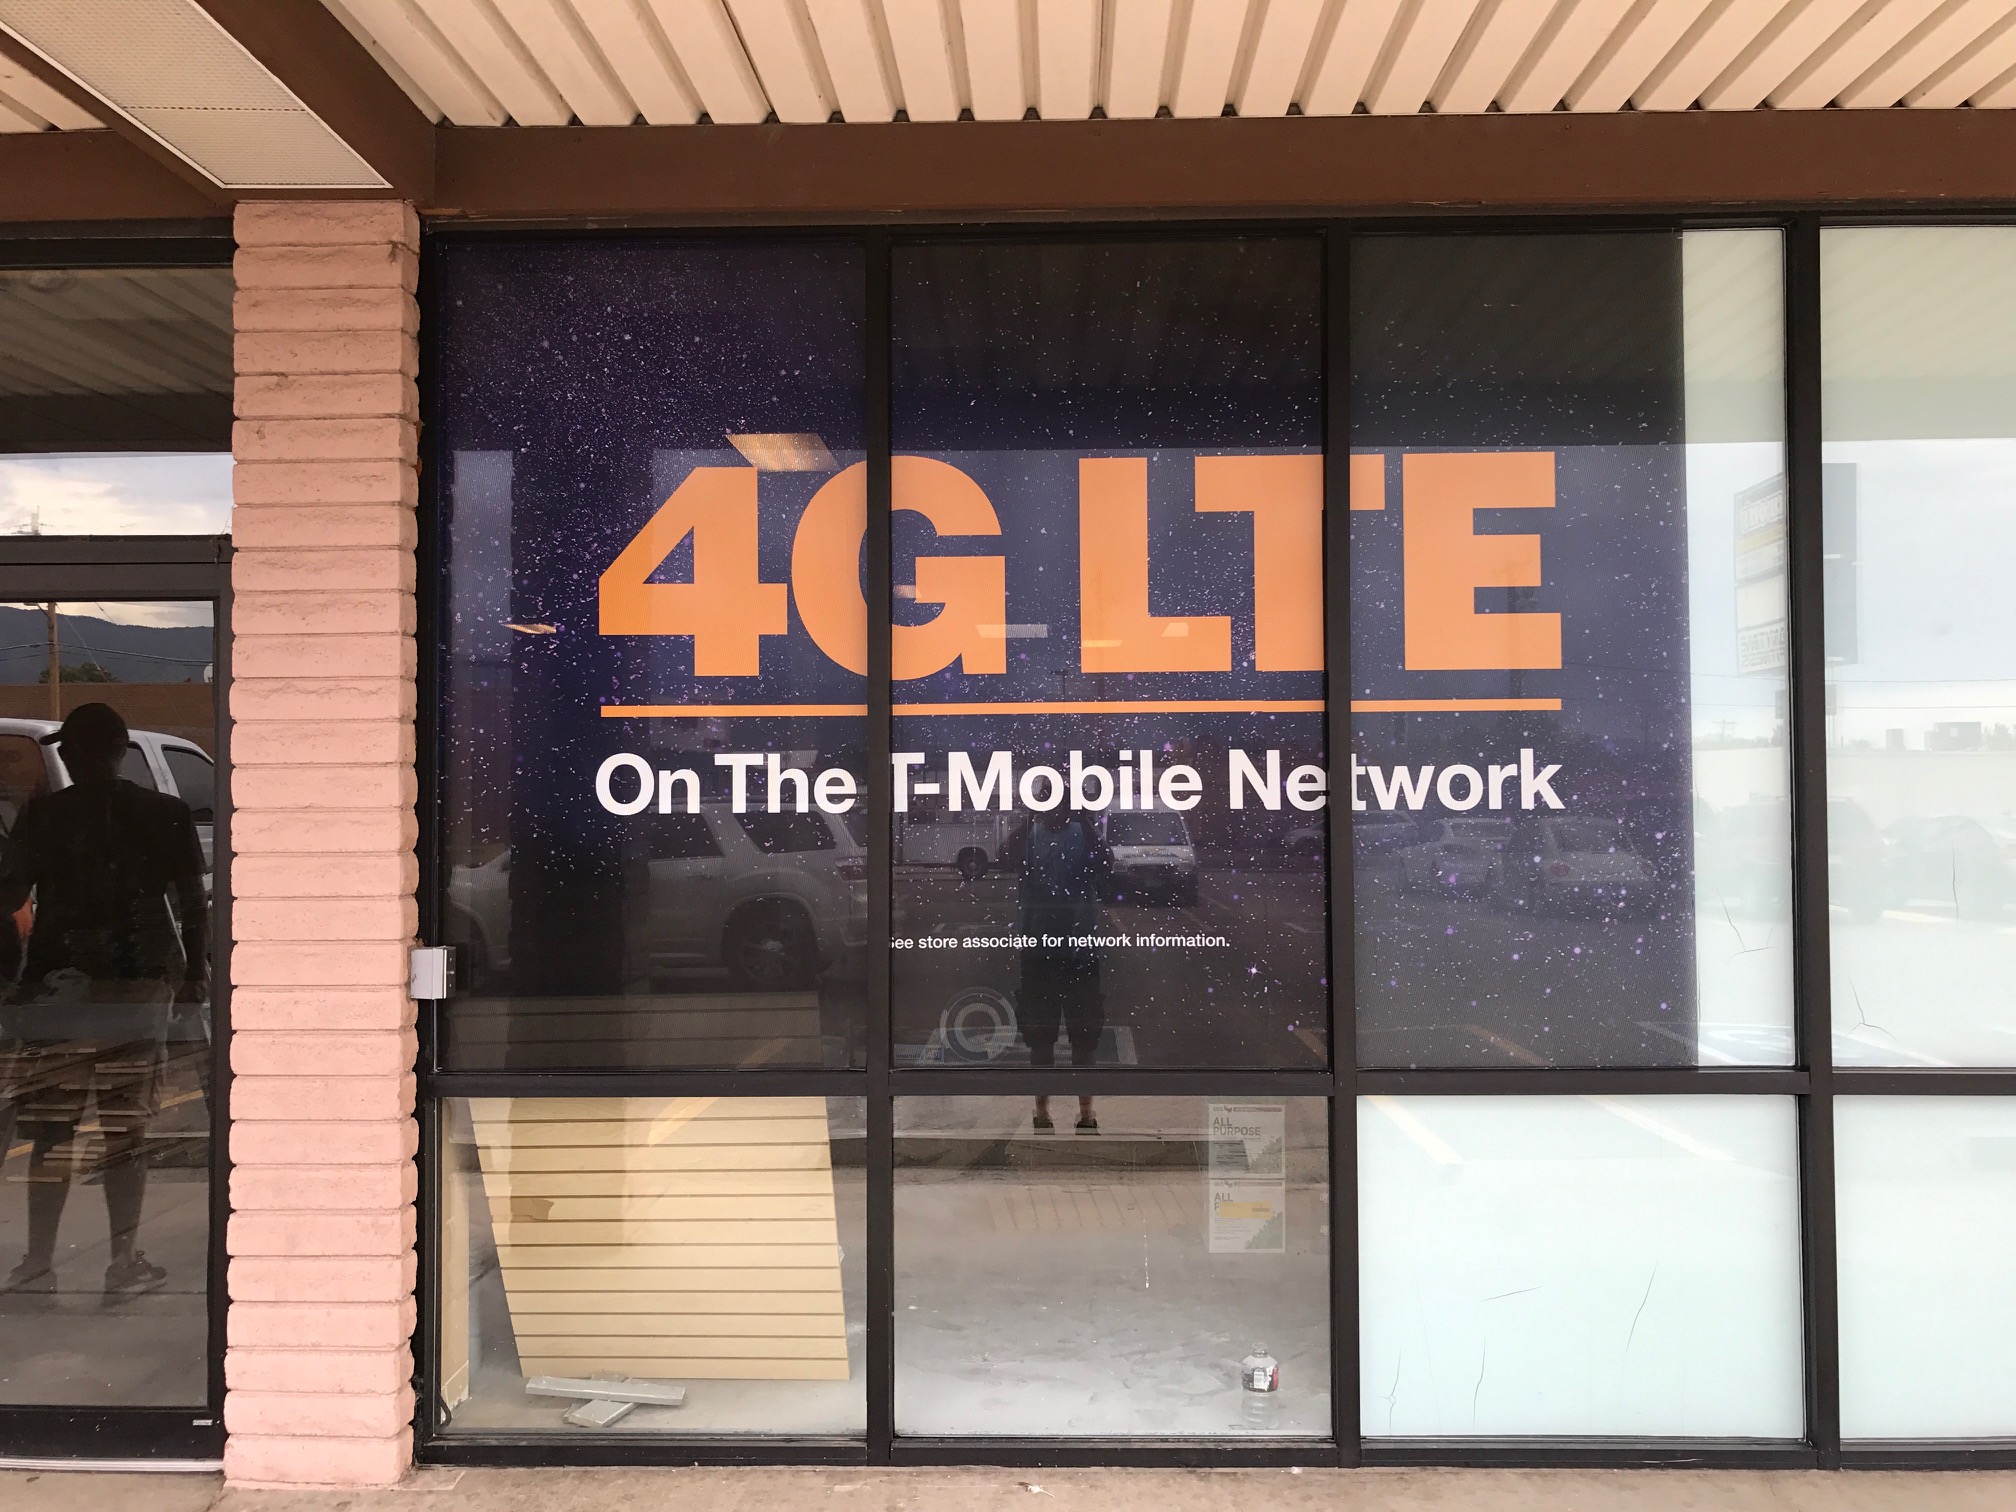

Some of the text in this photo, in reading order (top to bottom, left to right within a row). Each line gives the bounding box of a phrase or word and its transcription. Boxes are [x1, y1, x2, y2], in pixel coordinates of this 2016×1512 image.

[598, 452, 1562, 680] 4G LTE
[595, 748, 1566, 815] On The T-Mobile Network
[918, 935, 959, 948] store
[962, 934, 1038, 948] associate
[1042, 934, 1065, 948] for
[1068, 933, 1132, 948] network
[1136, 933, 1230, 948] information.
[1213, 1117, 1232, 1127] ALL
[1213, 1126, 1261, 1136] PURPOSE
[1214, 1192, 1233, 1202] ALL
